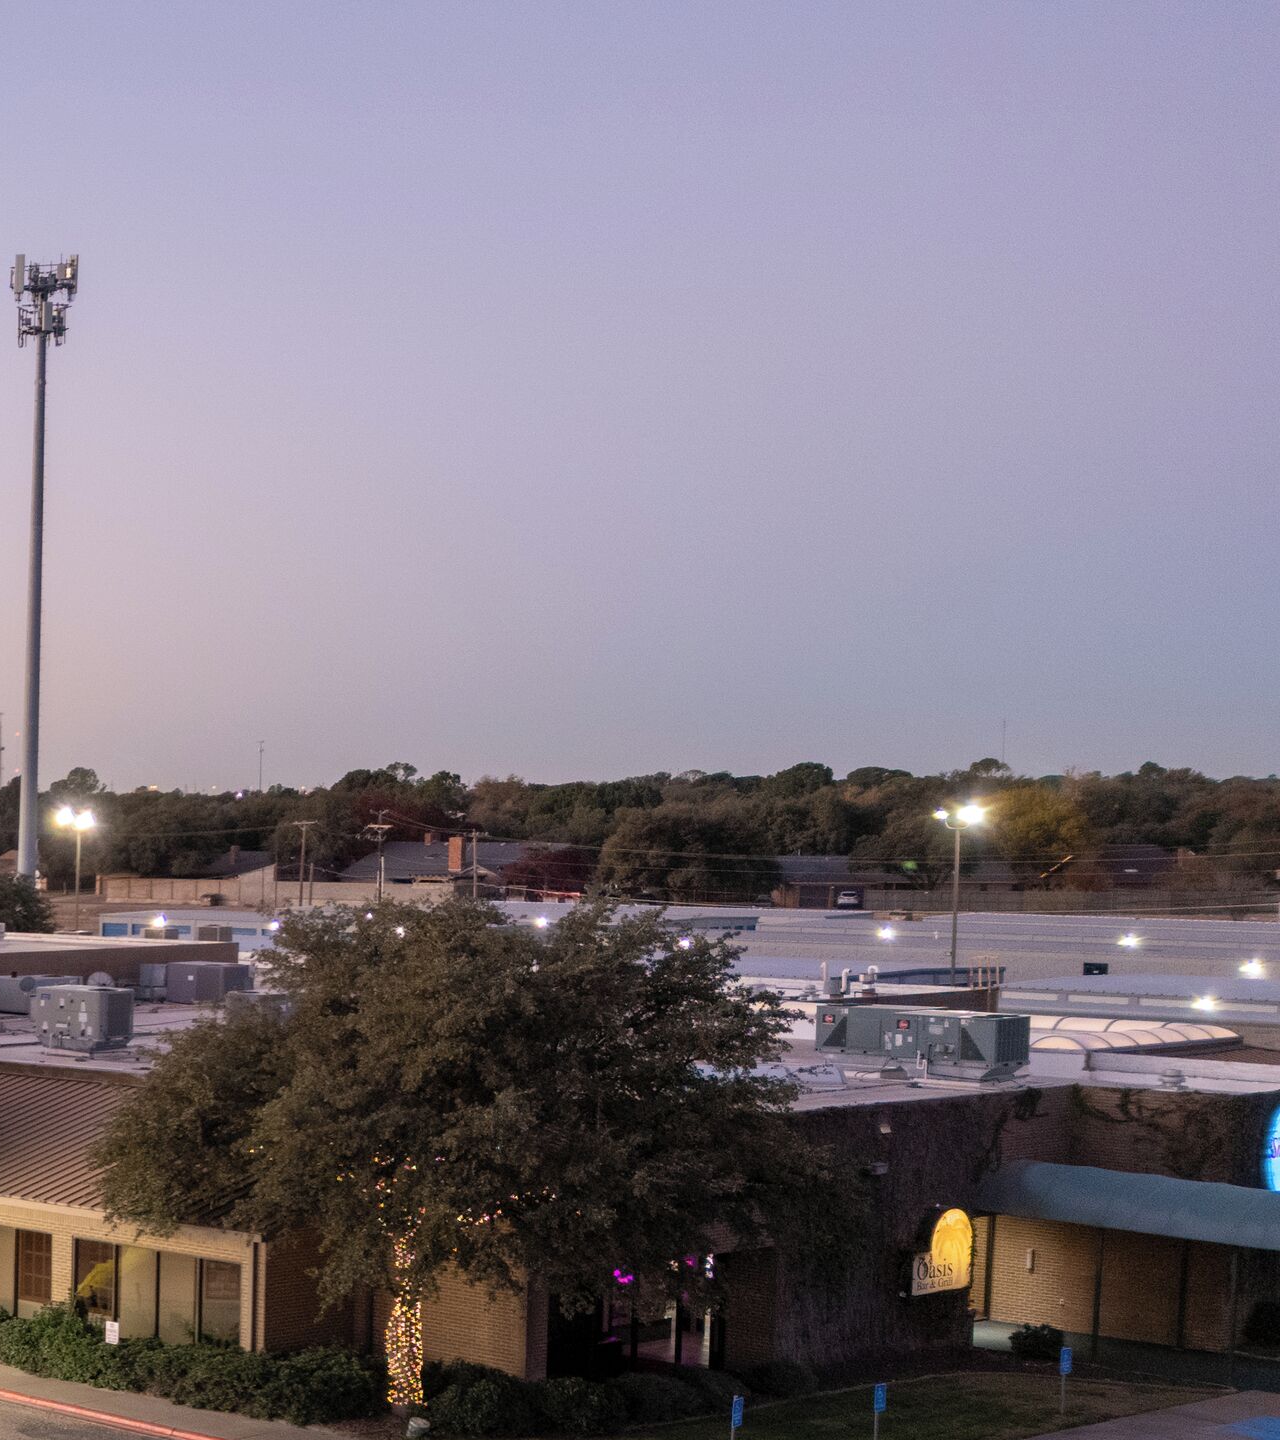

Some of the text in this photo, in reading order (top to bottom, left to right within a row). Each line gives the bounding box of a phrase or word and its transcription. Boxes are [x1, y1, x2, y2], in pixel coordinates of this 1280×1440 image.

[917, 1257, 953, 1281] Oasis
[916, 1276, 953, 1291] Bar & Grill
